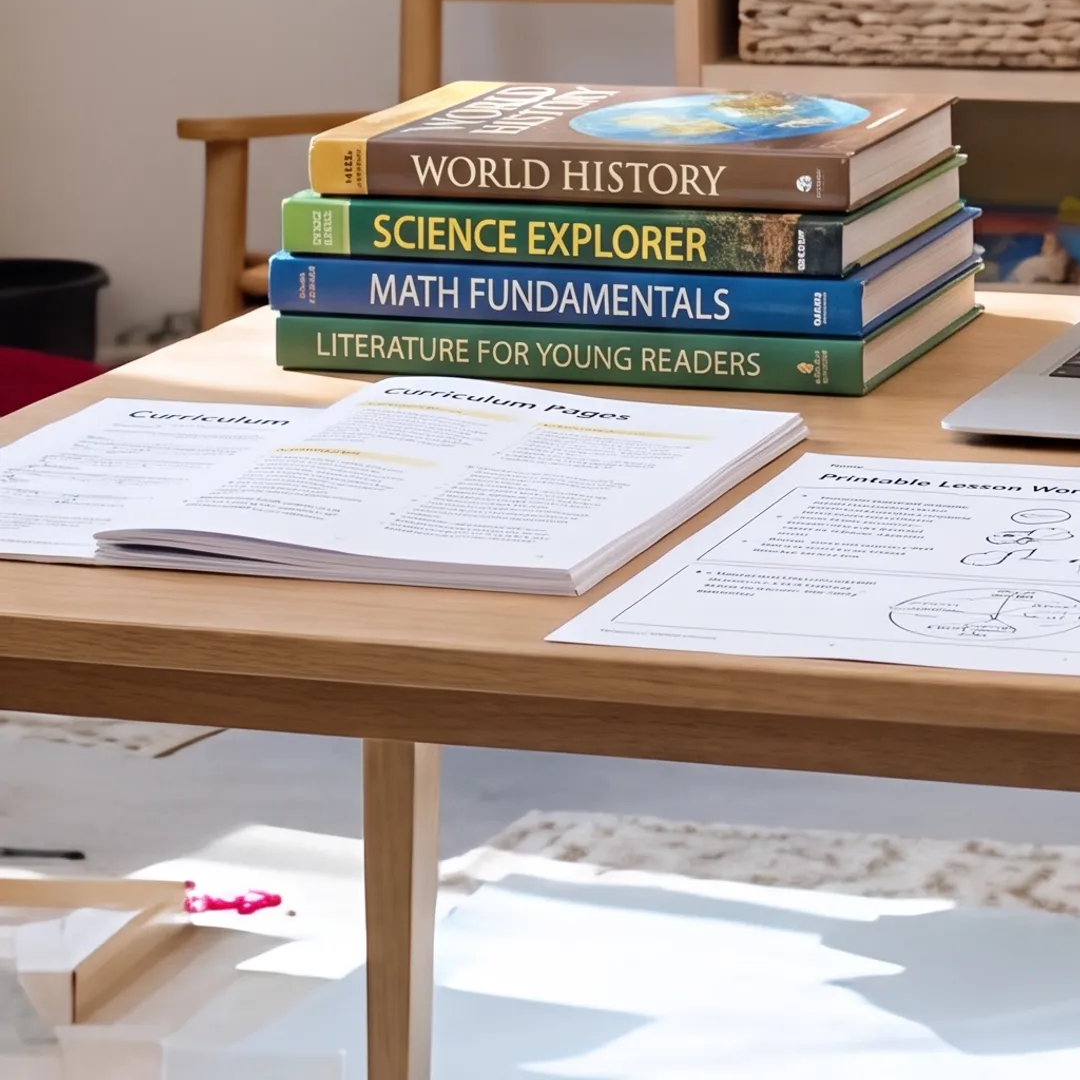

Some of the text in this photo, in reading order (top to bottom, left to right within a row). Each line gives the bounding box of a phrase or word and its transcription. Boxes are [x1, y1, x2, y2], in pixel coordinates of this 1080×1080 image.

[411, 154, 550, 189] WORLD
[563, 161, 726, 197] HISTORY
[373, 214, 517, 254] SCIENCE
[529, 221, 707, 262] EXPLORER
[370, 273, 730, 320] MATH FUNDAMENTALS
[316, 333, 761, 377] LITERATURE FOR YOUNG READERS
[129, 410, 290, 426] Curriculum
[384, 387, 631, 421] Curriculum Pages
[819, 473, 931, 486] Printable
[938, 481, 1022, 491] Lesson
